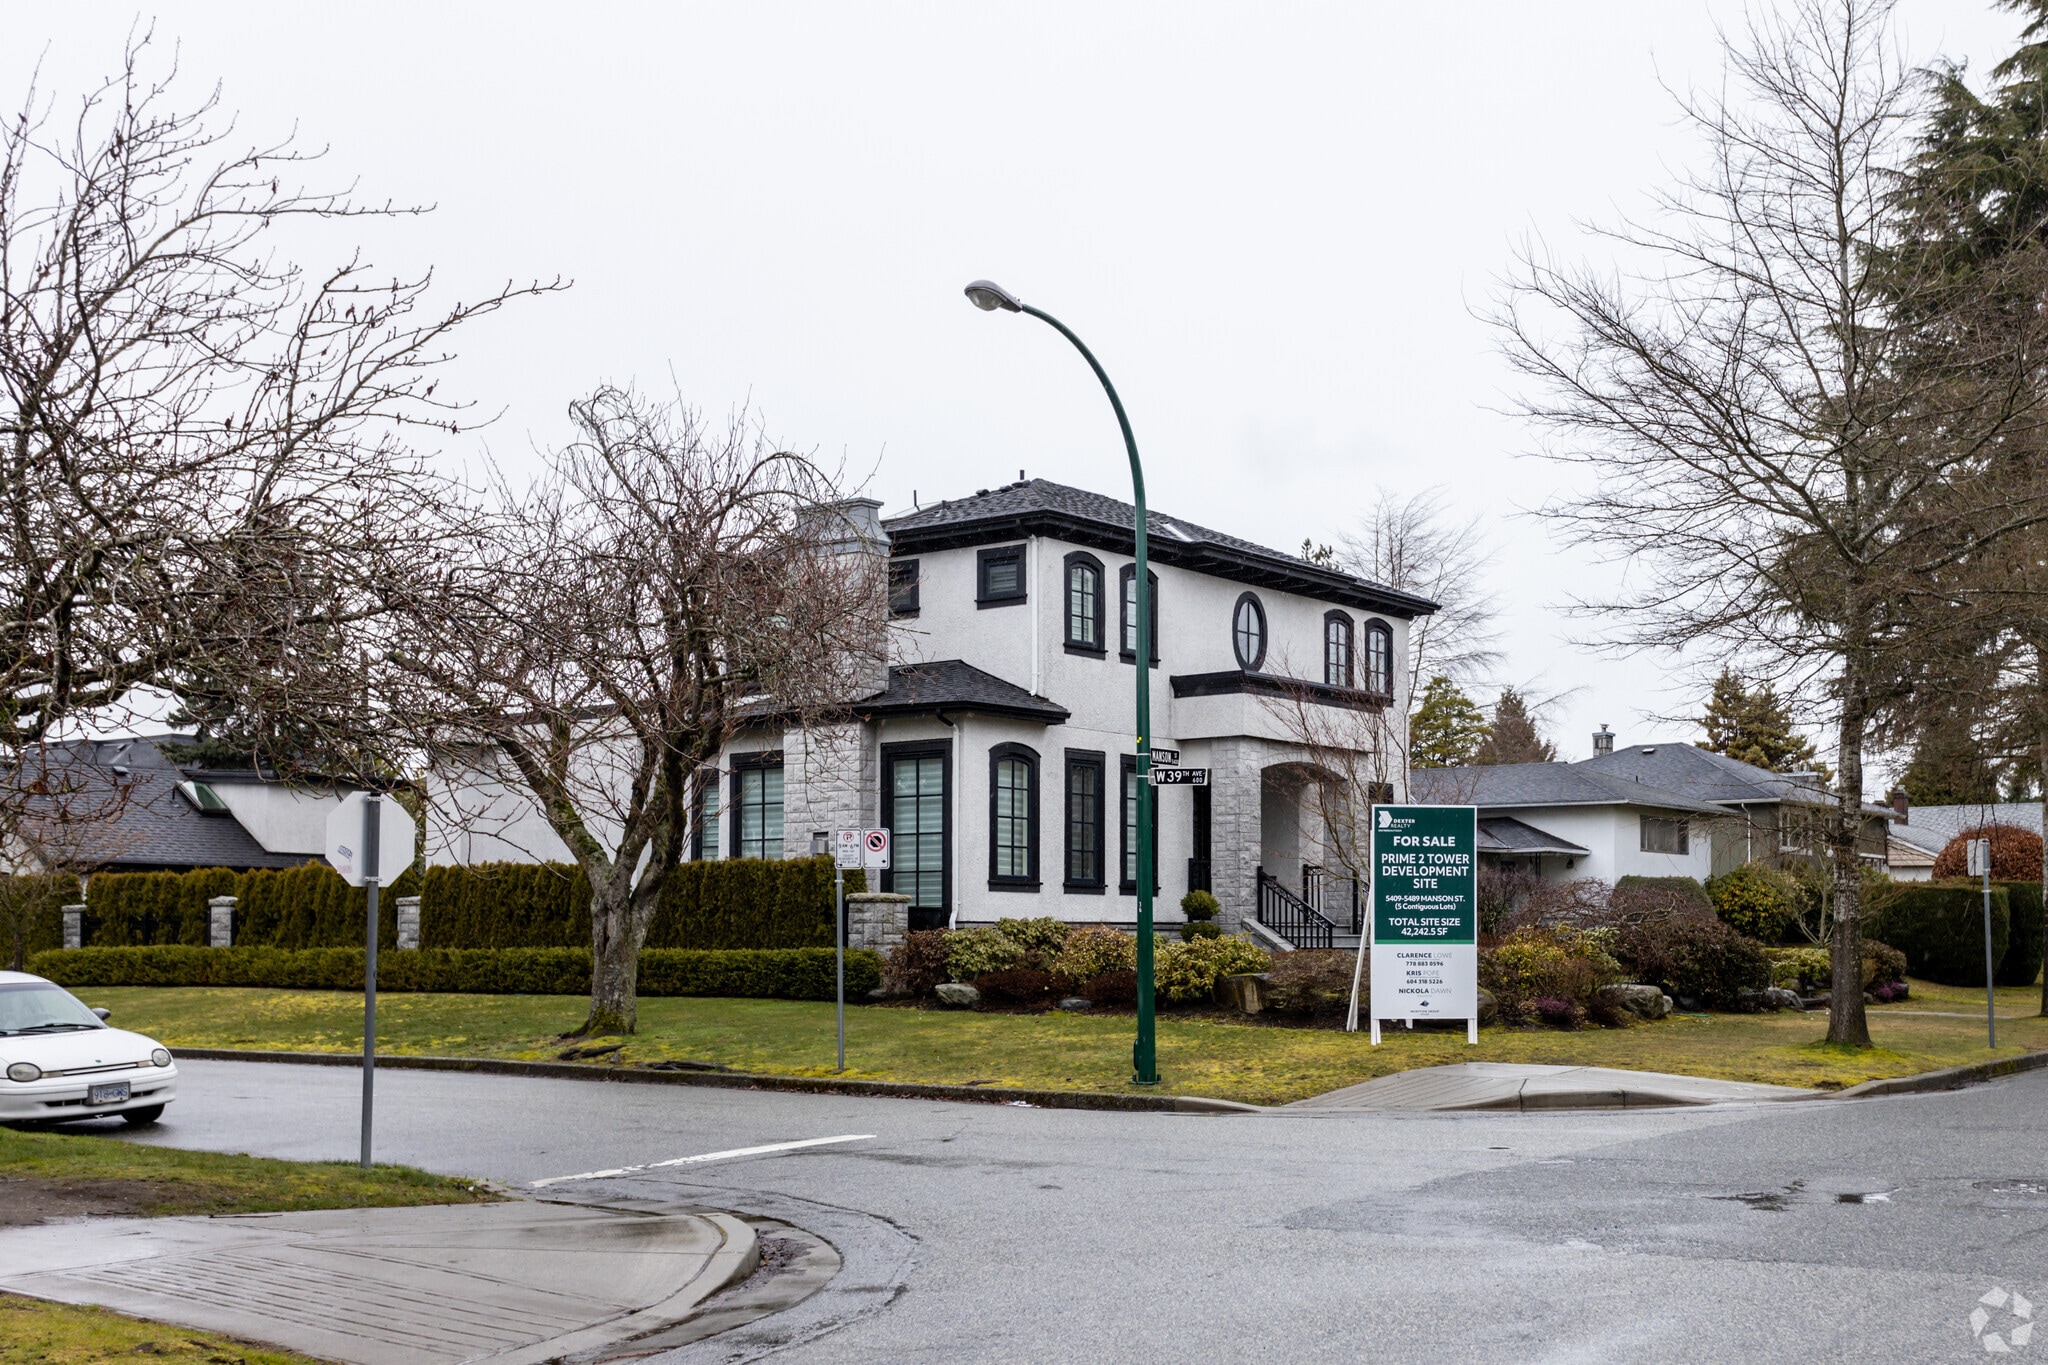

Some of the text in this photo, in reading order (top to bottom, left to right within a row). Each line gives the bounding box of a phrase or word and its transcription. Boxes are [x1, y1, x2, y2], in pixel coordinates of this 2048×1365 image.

[1151, 750, 1171, 763] MANSON
[1156, 770, 1166, 783] W
[1393, 836, 1456, 847] FOR SALE
[1381, 853, 1470, 864] PRIME 2 TOWER
[1382, 865, 1469, 876] DEVELOPMENT
[1413, 878, 1438, 889] SITE
[1394, 903, 1456, 912] (5 Contiguous Lots)
[1388, 918, 1461, 926] TOTAL SITE SIZE
[1401, 927, 1448, 937] 42,242.5 SF
